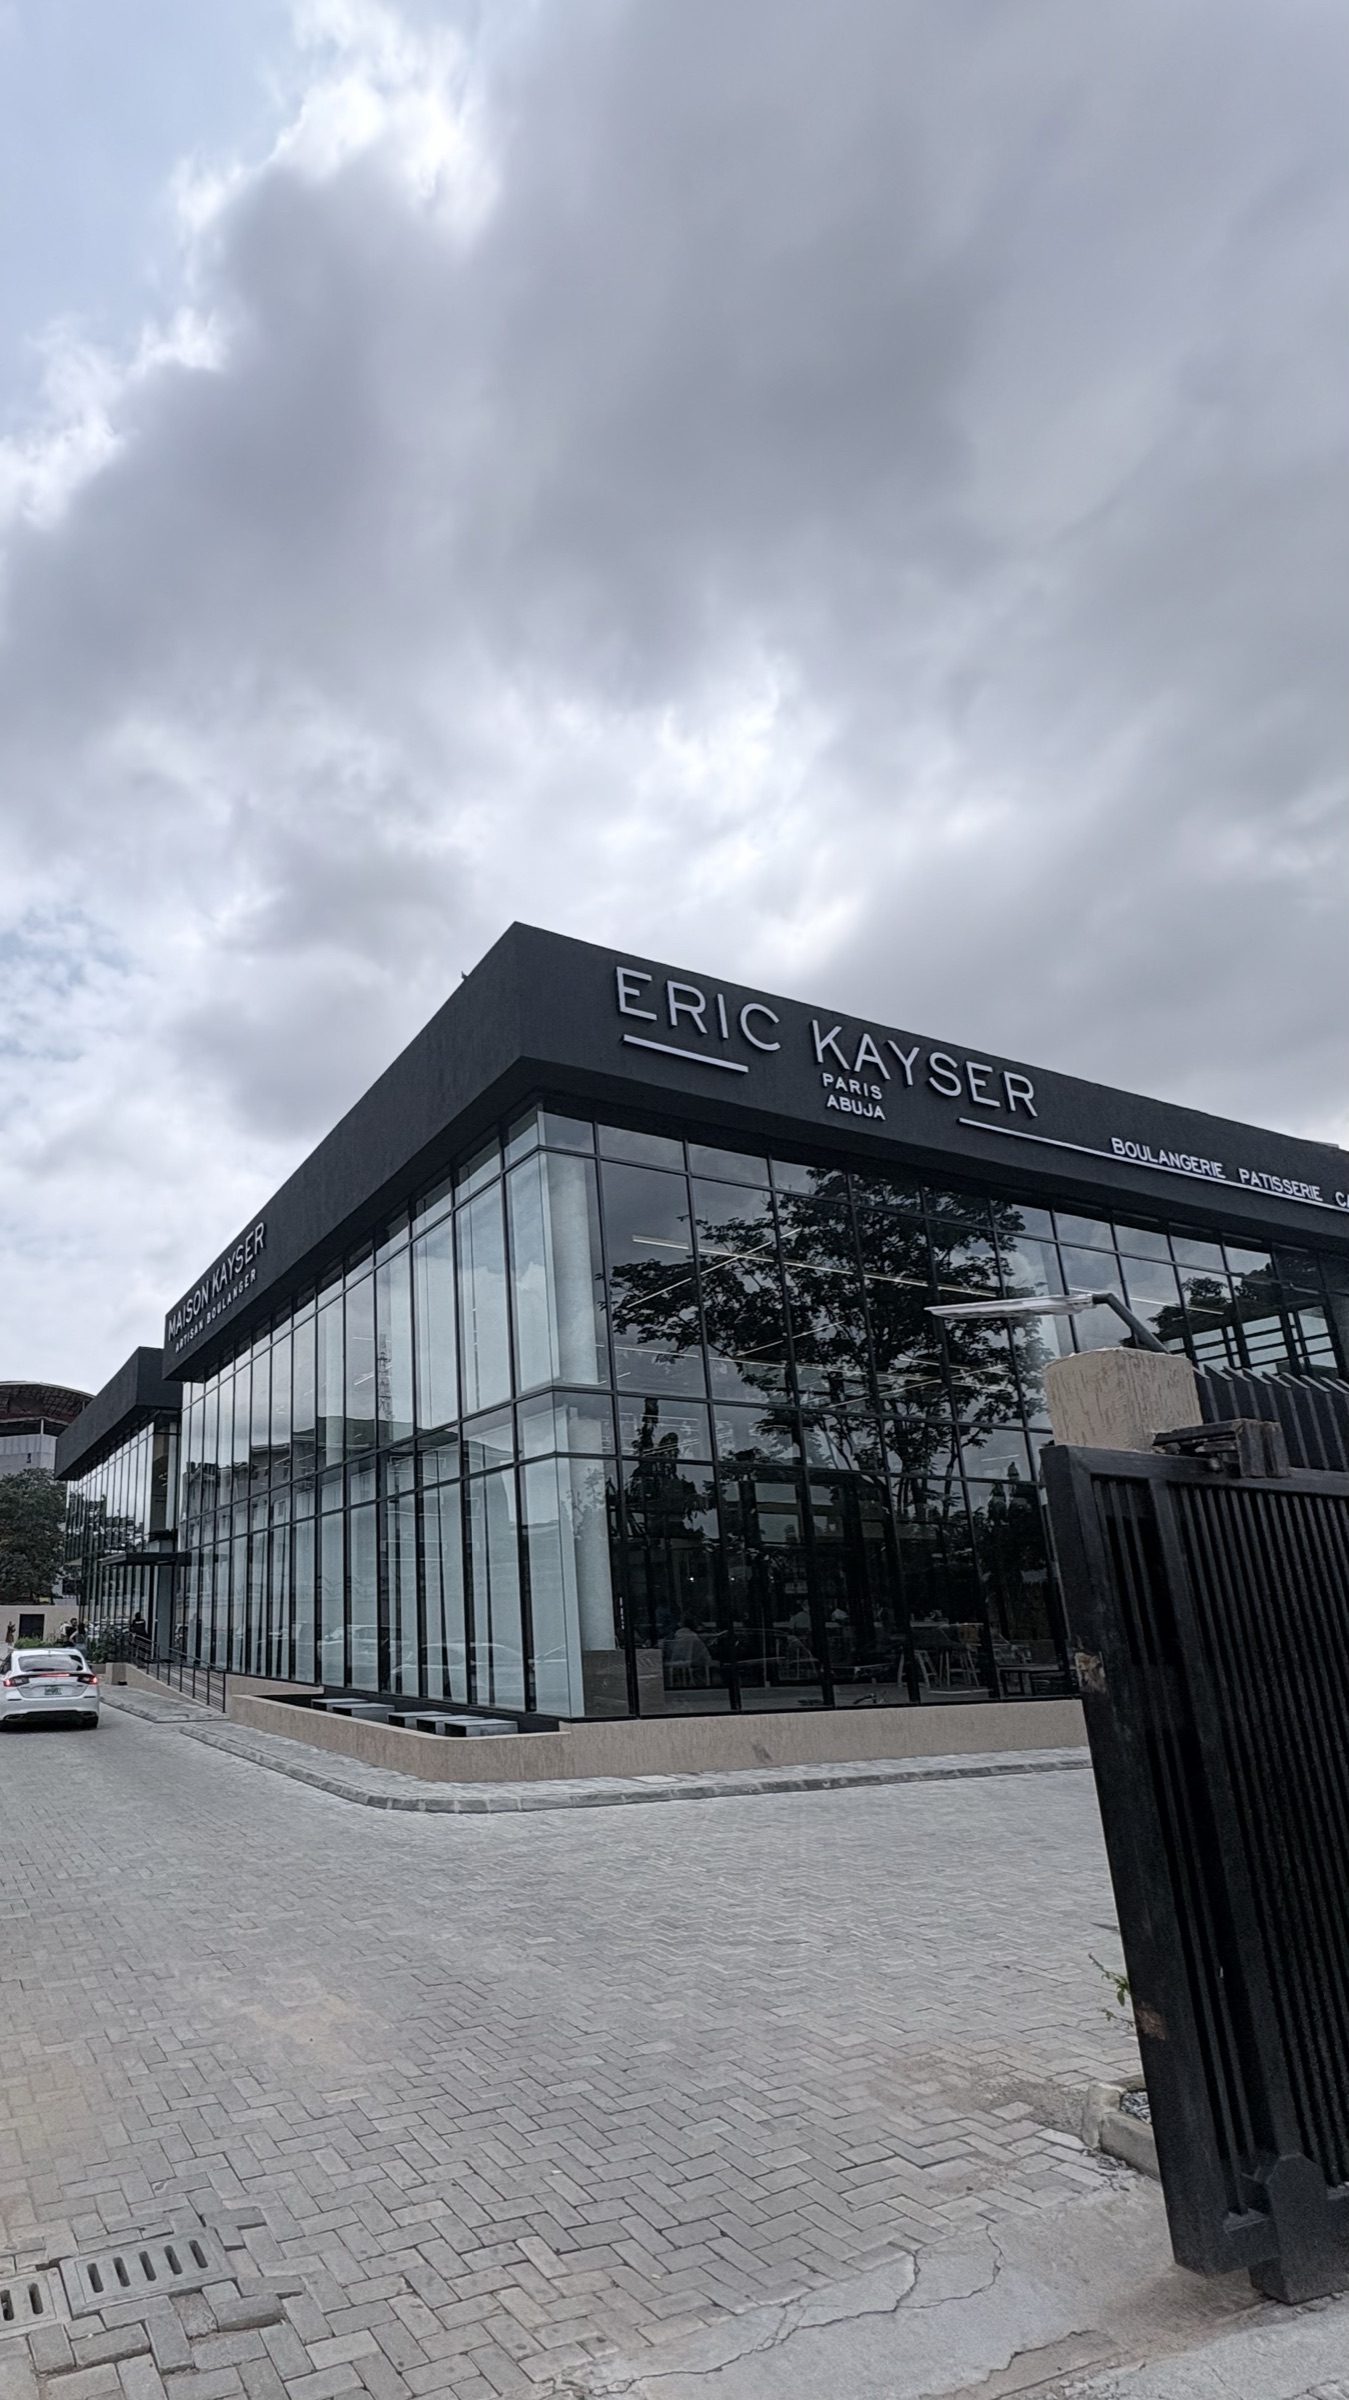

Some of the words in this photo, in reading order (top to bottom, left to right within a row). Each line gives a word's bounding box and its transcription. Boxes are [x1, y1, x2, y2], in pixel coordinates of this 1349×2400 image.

[615, 966, 782, 1052] ERIC
[811, 1018, 1038, 1118] KAYSER
[822, 1072, 883, 1100] PARIS
[826, 1094, 887, 1121] ABUJA
[1111, 1137, 1227, 1179] BOULANGERIE
[1238, 1168, 1324, 1202] PATISSERIE
[168, 1280, 210, 1342] MAISON
[212, 1222, 265, 1298] KAYSER
[175, 1319, 204, 1354] ARTISAN
[206, 1268, 257, 1325] BOULANGER
